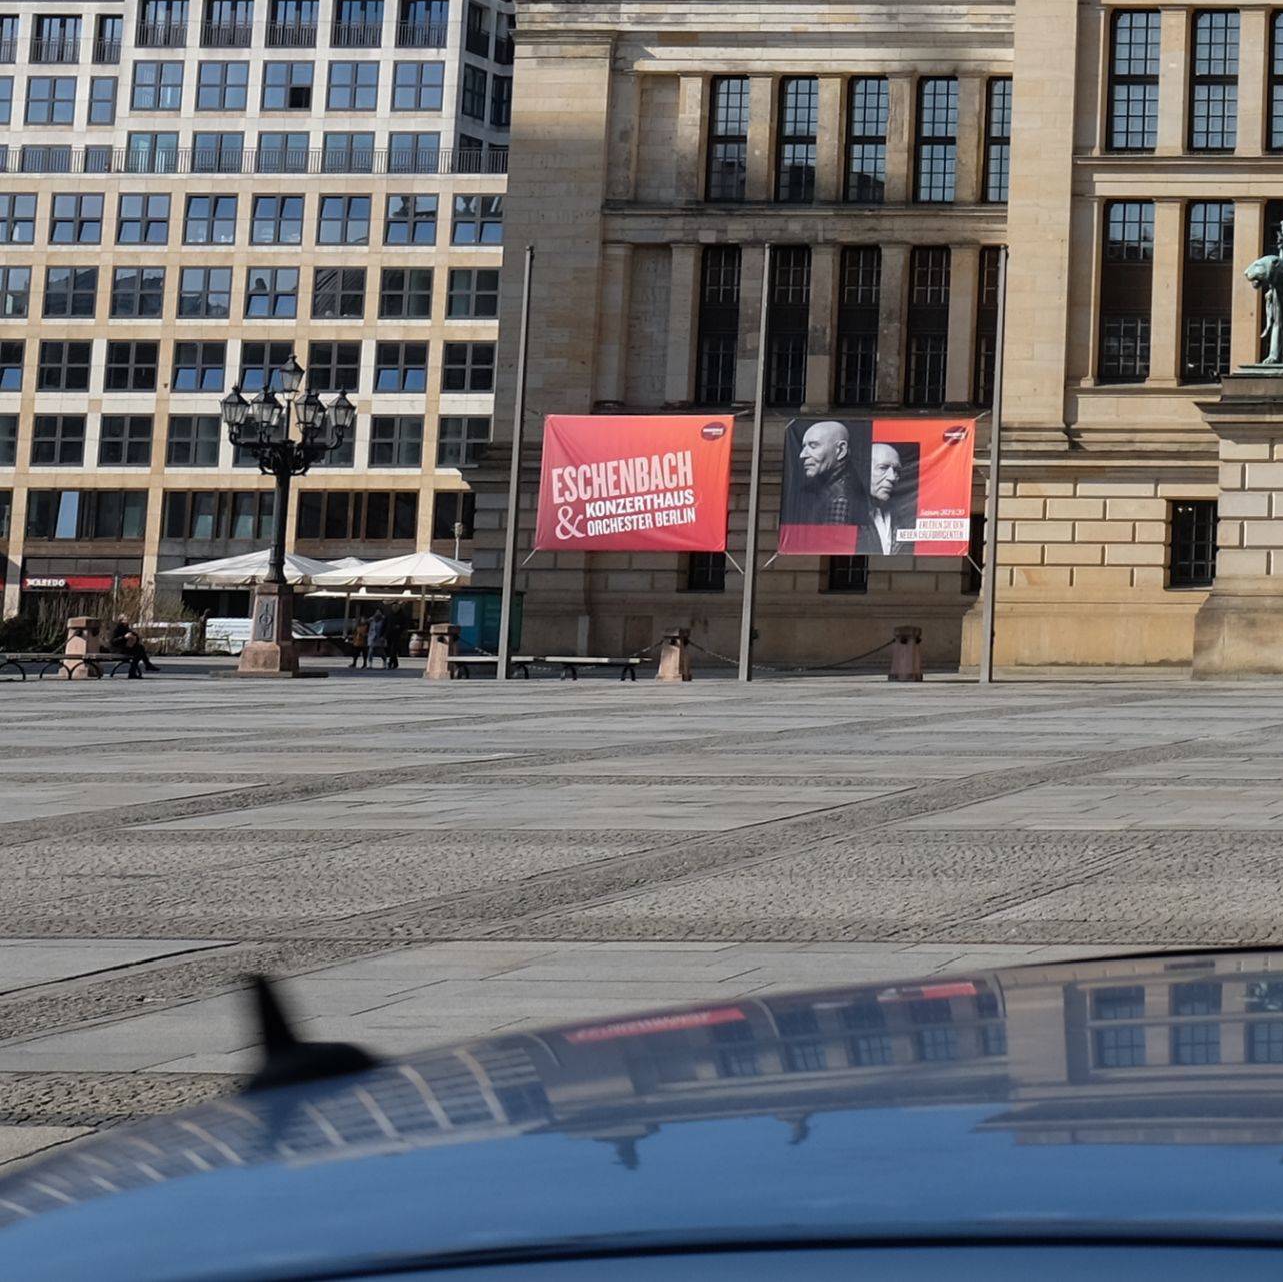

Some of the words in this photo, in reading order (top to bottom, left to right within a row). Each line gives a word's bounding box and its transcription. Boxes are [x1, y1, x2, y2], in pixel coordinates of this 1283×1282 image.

[551, 450, 694, 504] ESCHENBACH
[585, 489, 695, 518] KONZERTHAUS
[555, 505, 587, 540] &
[587, 513, 654, 537] ORCHESTER
[655, 507, 696, 527] BERLIN
